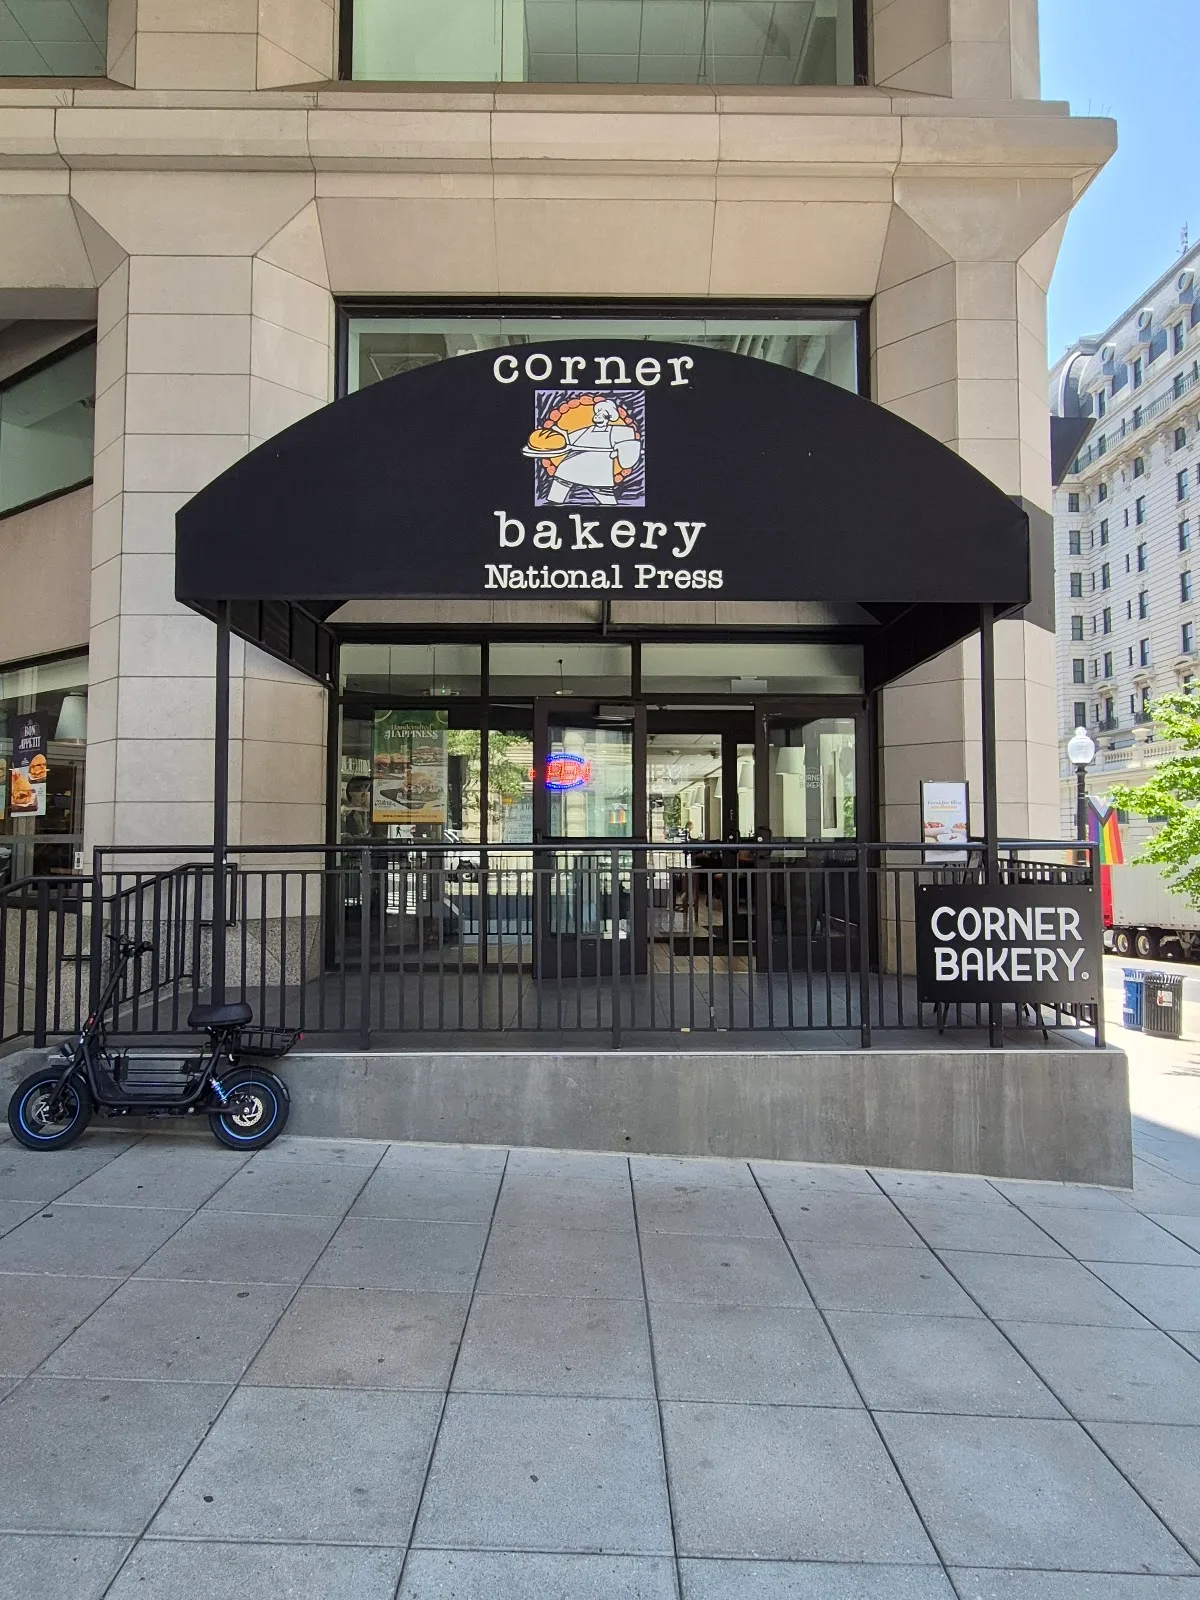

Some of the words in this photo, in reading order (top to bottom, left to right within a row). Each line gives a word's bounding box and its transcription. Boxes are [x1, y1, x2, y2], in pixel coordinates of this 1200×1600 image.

[493, 353, 695, 386] corner
[493, 511, 706, 558] bakery
[484, 565, 623, 589] National
[634, 565, 723, 589] Press
[384, 730, 438, 739] HAPPINESS
[931, 906, 1082, 941] CORNER
